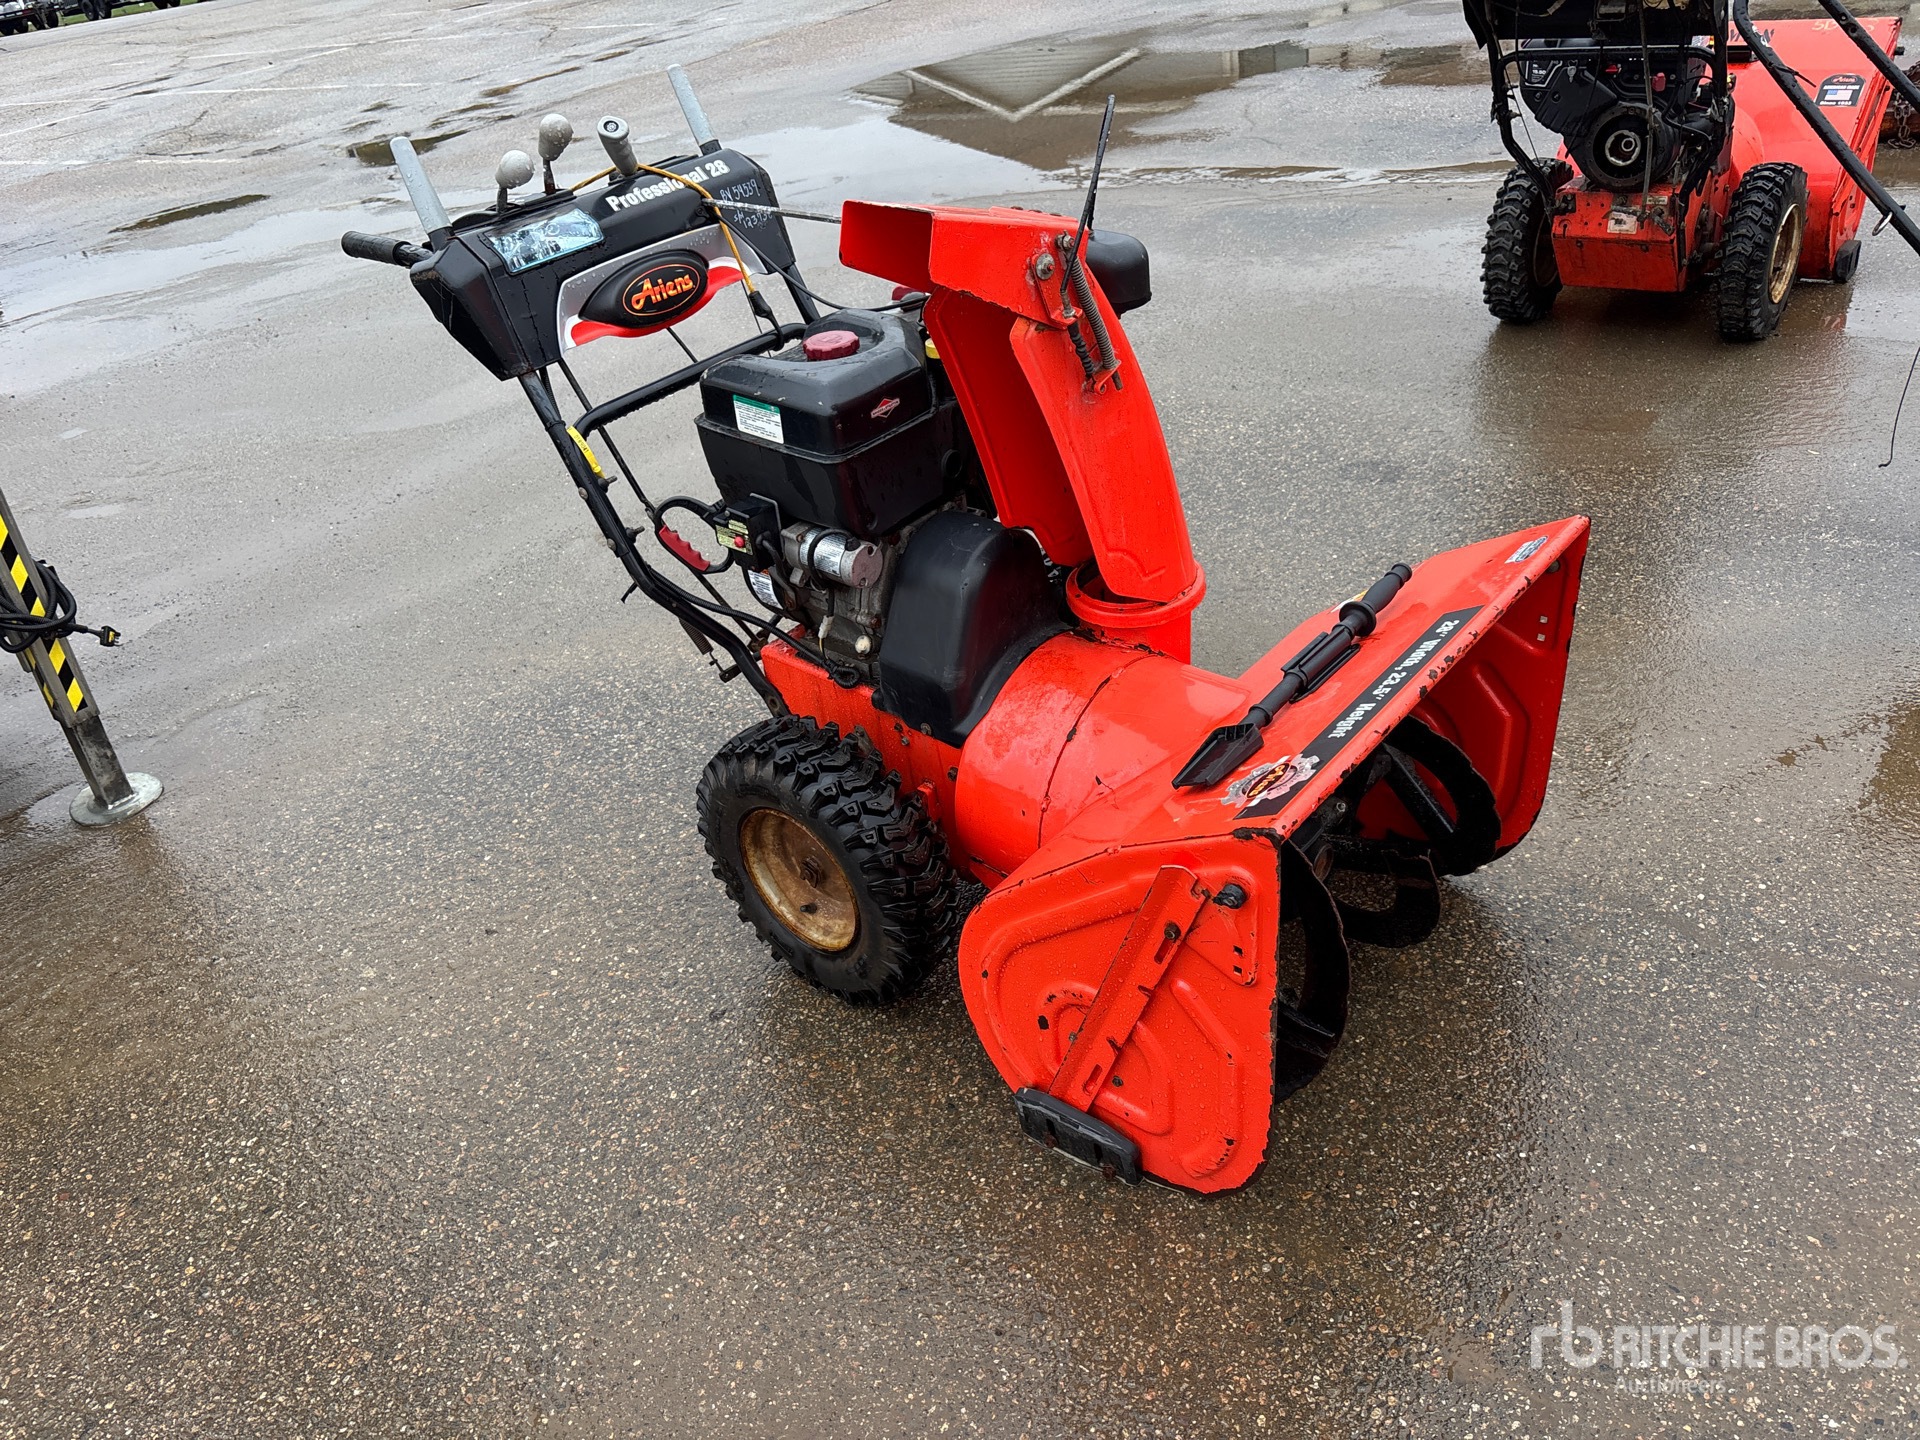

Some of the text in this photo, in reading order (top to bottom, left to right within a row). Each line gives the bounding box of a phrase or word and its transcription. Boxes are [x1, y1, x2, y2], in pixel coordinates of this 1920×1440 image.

[704, 159, 731, 178] 28
[631, 274, 695, 310] Ariens
[1327, 702, 1377, 738] Height
